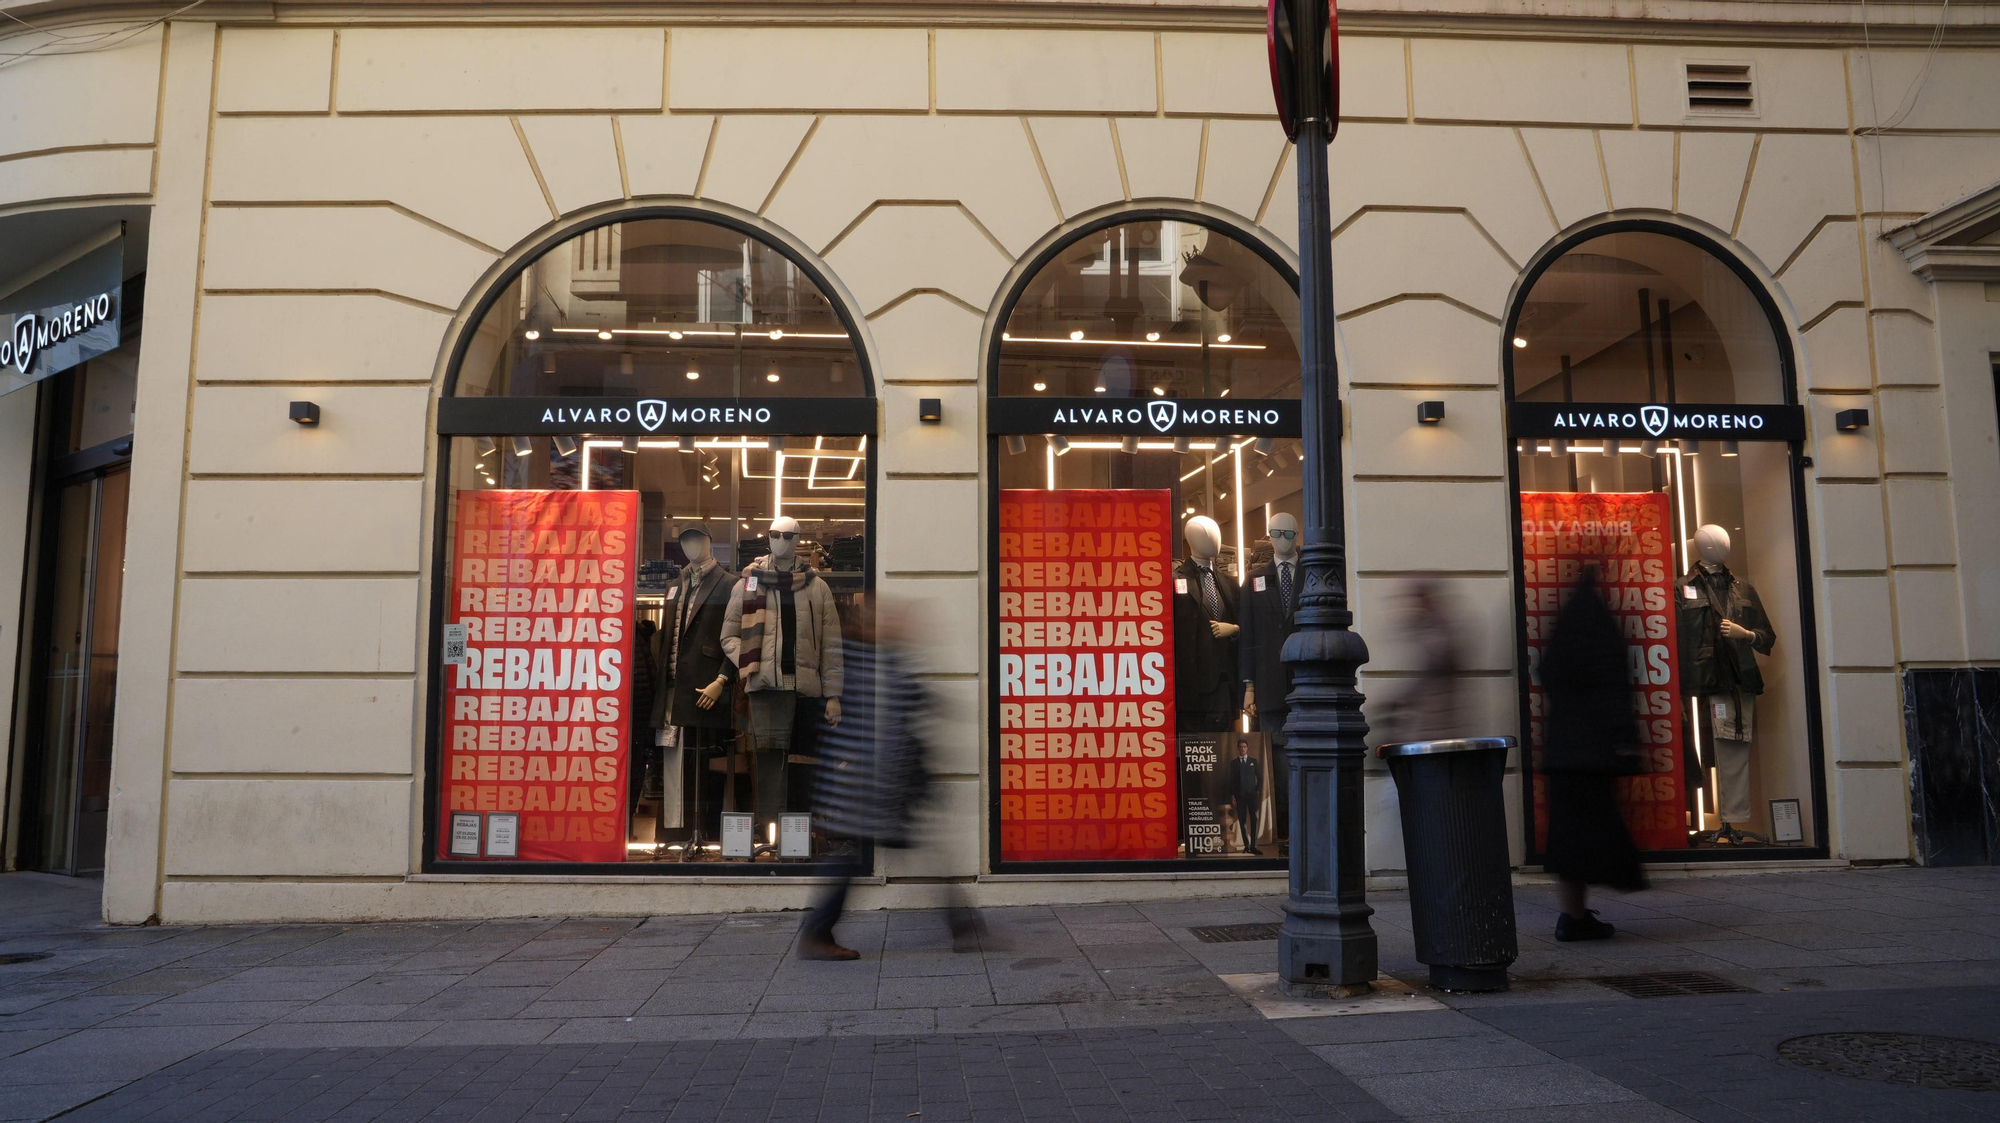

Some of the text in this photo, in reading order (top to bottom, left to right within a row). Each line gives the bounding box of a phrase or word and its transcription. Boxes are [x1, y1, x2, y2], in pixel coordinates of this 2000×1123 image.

[37, 293, 109, 350] MORENO
[541, 408, 631, 423] ALVARO
[672, 408, 771, 423] MORENO
[1053, 408, 1142, 424] ALVARO
[1182, 409, 1280, 425] MORENO
[1554, 413, 1637, 428] ALVARO
[1673, 414, 1764, 429] MORENO
[465, 500, 627, 526] REBAJAS
[1000, 502, 1162, 528] REBAJAS
[463, 529, 626, 555] REBAJAS
[1000, 532, 1162, 557] REBAJAS
[461, 558, 625, 584] REBAJAS
[1000, 561, 1163, 587] REBAJAS
[460, 587, 624, 613] REBAJAS
[1000, 591, 1163, 617] REBAJAS
[459, 616, 623, 642] REBAJAS
[1000, 621, 1164, 647] REBAJAS
[456, 647, 622, 691] REBAJAS
[1000, 652, 1165, 697] REBAJAS
[454, 695, 620, 722] REBAJAS
[1000, 701, 1165, 729] REBAJAS
[453, 725, 619, 752] REBAJAS
[1000, 731, 1166, 759] REBAJAS
[1185, 746, 1213, 754] PACK
[451, 755, 618, 782] REBAJAS
[1185, 755, 1217, 763] TRAJE
[1186, 763, 1213, 772] ARTE
[1000, 762, 1166, 790] REBAJAS
[450, 785, 617, 813] REBAJAS
[1001, 792, 1167, 820] REBAJAS
[1001, 823, 1167, 851] REBAJAS
[1190, 826, 1219, 834] TODO
[1190, 836, 1213, 853] 149
